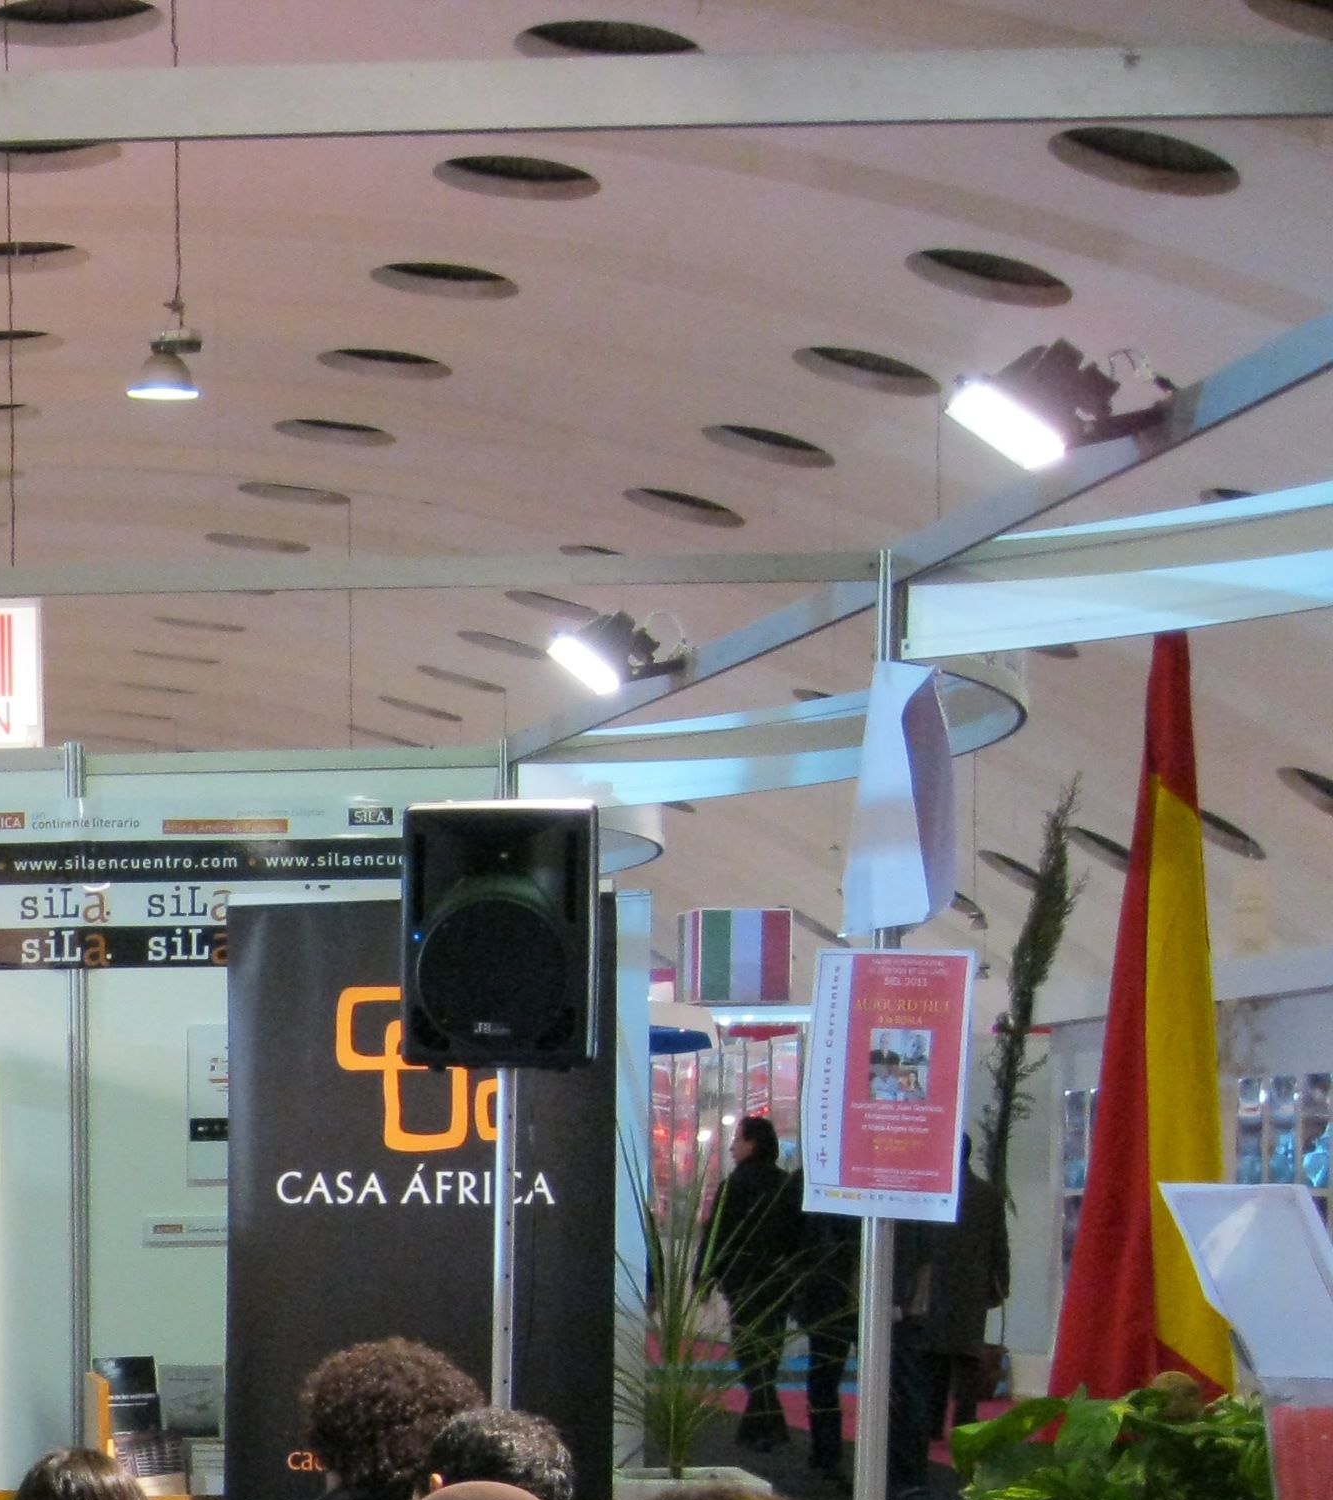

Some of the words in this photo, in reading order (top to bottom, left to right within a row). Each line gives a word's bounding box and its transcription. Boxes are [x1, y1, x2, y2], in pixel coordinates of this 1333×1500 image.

[32, 818, 90, 830] continente
[92, 817, 140, 829] literario
[353, 809, 391, 825] SILA,
[14, 855, 238, 872] www.silaencuentro.com
[265, 850, 404, 868] www.silaencu
[818, 1056, 832, 1138] Instituto
[825, 965, 841, 1048] Cervantes
[276, 1171, 387, 1205] CASA
